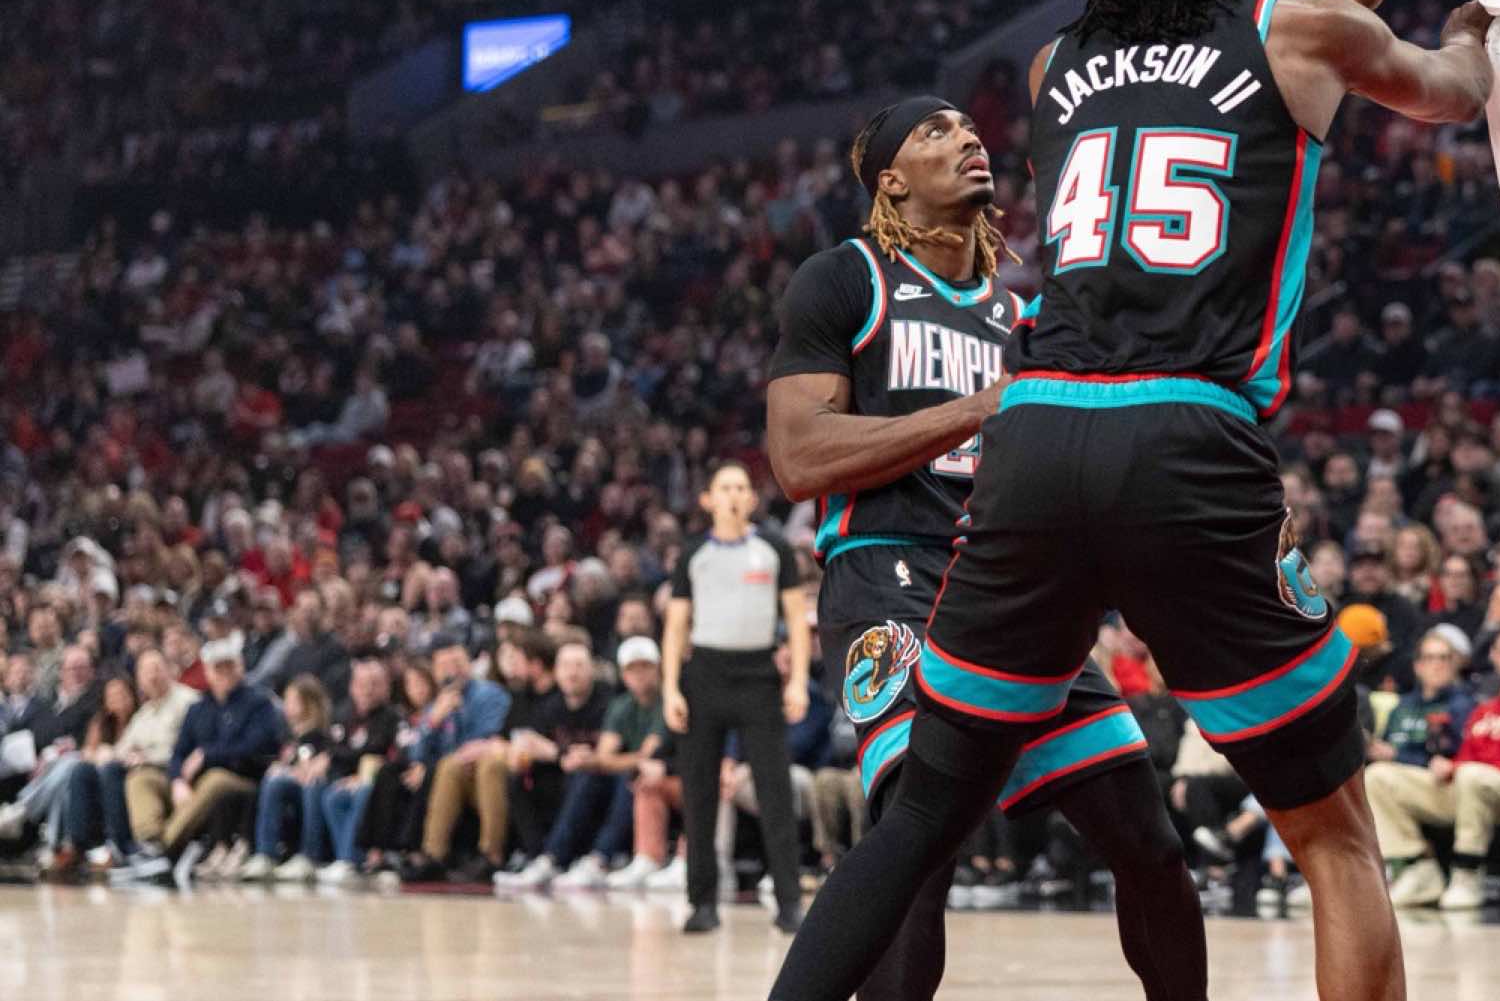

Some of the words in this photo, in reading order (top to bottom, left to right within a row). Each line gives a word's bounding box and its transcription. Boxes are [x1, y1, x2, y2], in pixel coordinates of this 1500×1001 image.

[1049, 44, 1222, 125] JACKSON
[1209, 69, 1262, 114] II
[1045, 126, 1239, 276] 45
[887, 319, 1006, 397] MEMPH
